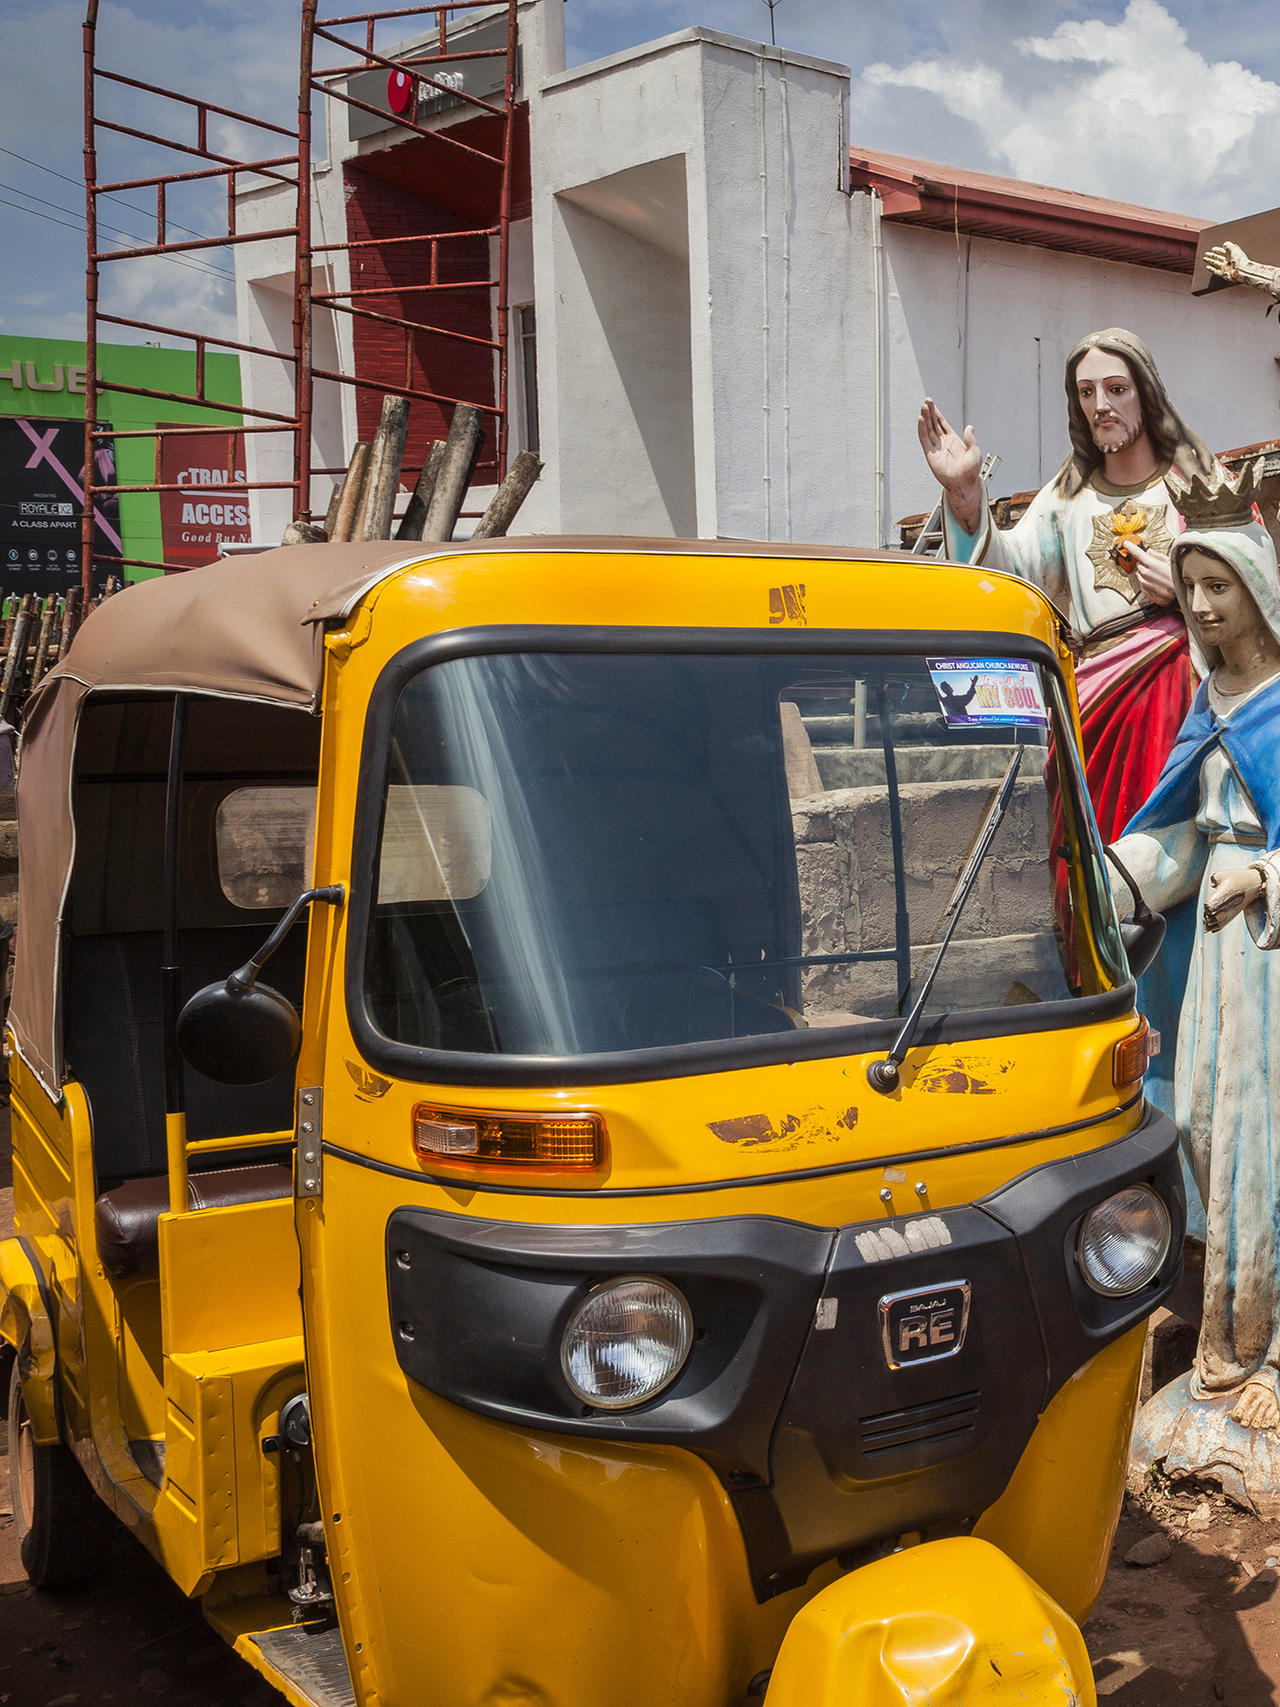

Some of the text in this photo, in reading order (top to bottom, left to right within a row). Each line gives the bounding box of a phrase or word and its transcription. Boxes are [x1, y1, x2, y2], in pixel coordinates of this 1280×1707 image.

[20, 503, 58, 515] ROYALE
[19, 520, 49, 528] CLASS
[50, 521, 78, 529] APART
[181, 531, 212, 543] Good
[935, 662, 955, 670] CHRIST
[956, 662, 984, 670] ANGLICAN
[975, 684, 1041, 710] MY SOUL
[910, 1298, 947, 1314] BAJAJ
[899, 1308, 955, 1352] RE
